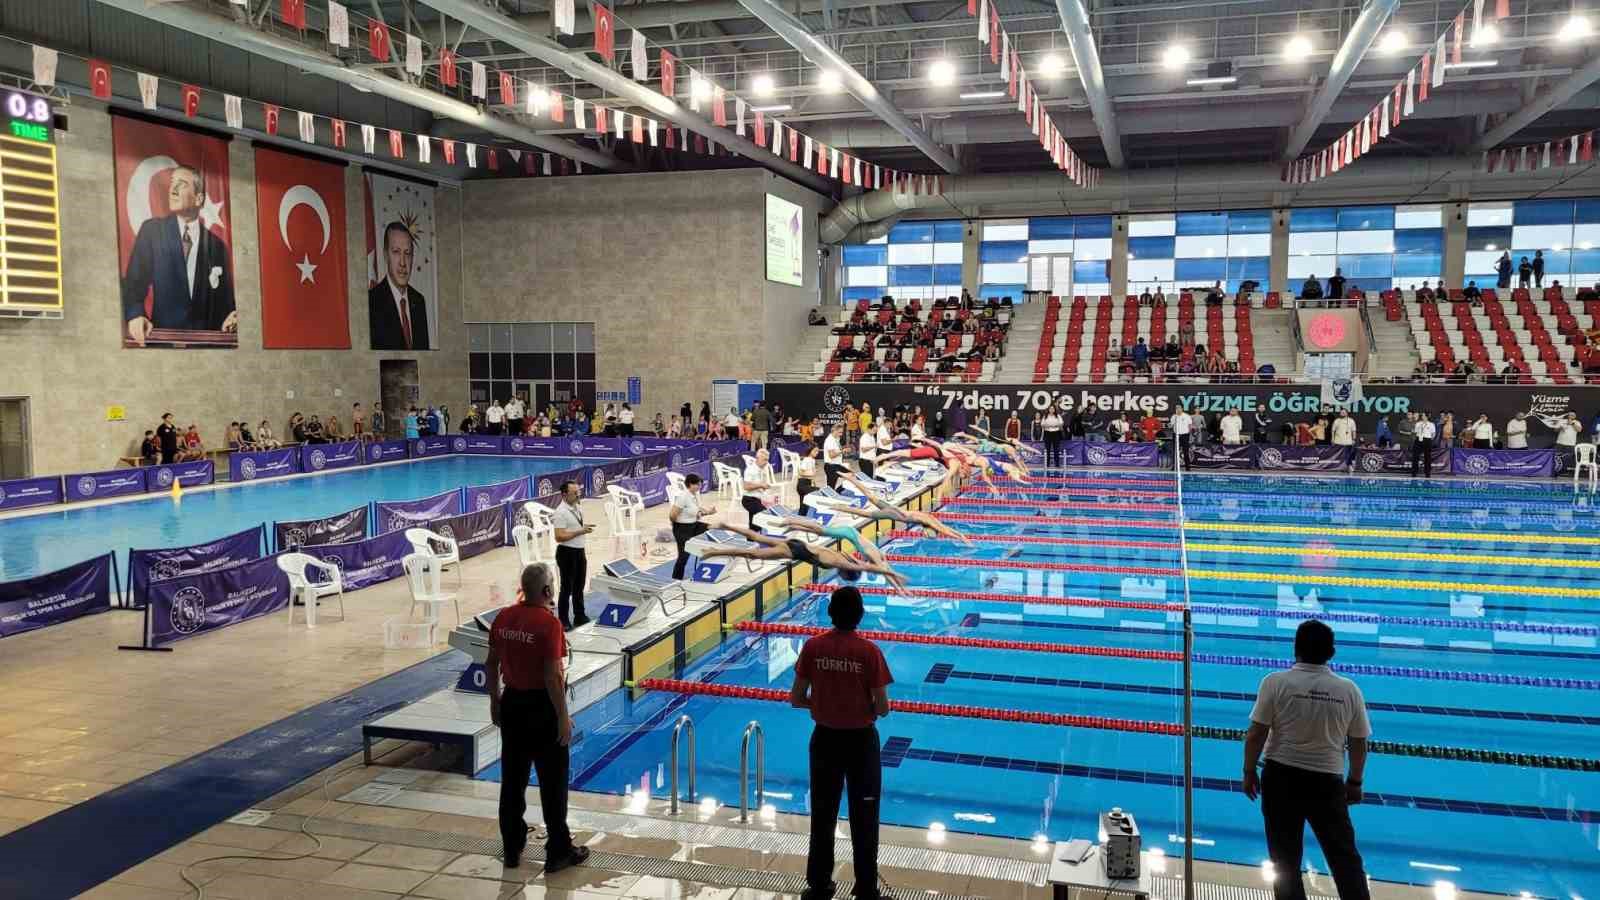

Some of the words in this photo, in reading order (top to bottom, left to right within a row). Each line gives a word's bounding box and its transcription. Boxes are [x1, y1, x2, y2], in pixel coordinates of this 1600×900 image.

[8, 93, 49, 121] 0.8
[11, 121, 48, 141] TIME
[1081, 390, 1169, 411] herkes
[1180, 391, 1257, 412] YÜZME
[1531, 394, 1570, 403] Yüzme
[701, 566, 712, 579] 2
[610, 608, 619, 623] 1
[816, 656, 863, 673] TÜRKİYE
[473, 669, 487, 687] 0
